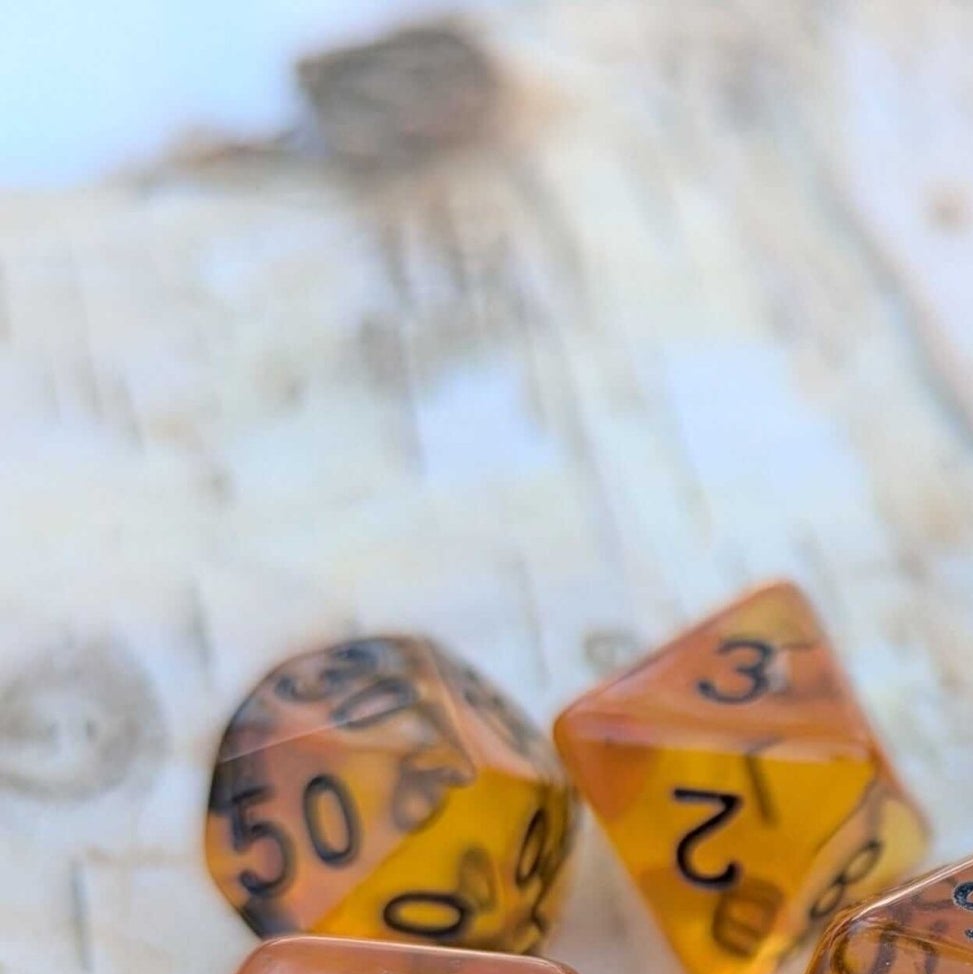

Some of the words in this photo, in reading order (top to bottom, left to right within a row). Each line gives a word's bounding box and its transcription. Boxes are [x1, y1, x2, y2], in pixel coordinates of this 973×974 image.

[696, 638, 776, 706] 3
[226, 774, 362, 898] 50
[672, 787, 744, 891] 2
